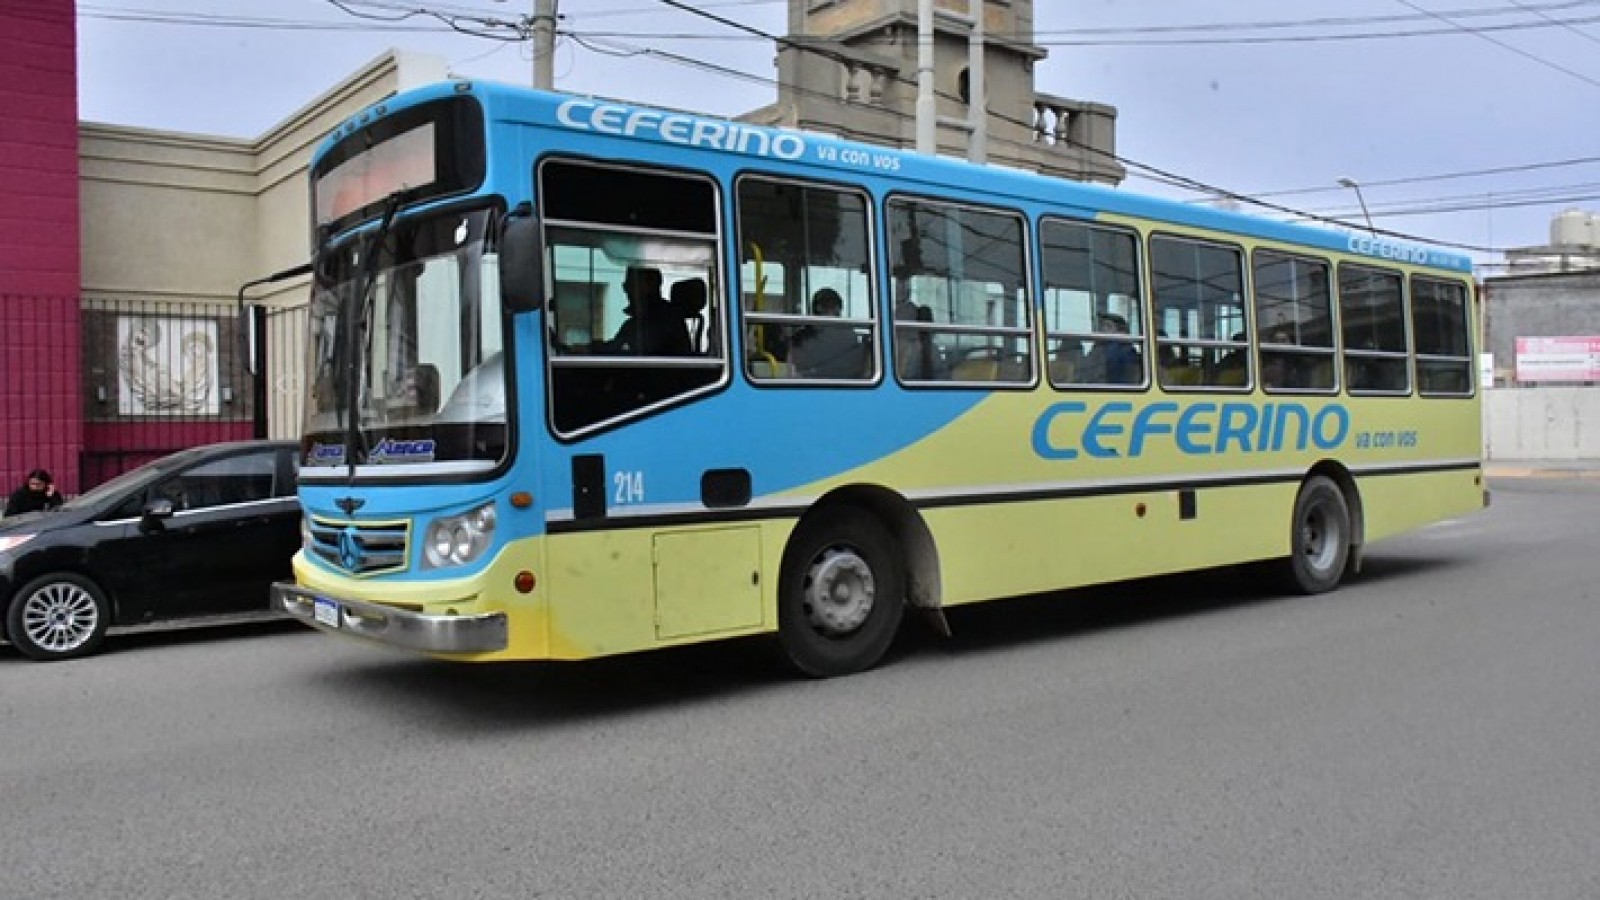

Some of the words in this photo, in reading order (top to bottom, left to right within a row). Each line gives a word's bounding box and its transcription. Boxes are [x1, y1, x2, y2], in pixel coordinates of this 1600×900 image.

[555, 99, 805, 160] CEFERINO
[841, 149, 869, 166] con
[873, 154, 900, 170] vos
[1031, 401, 1350, 460] CEFERINO
[614, 470, 644, 503] 214
